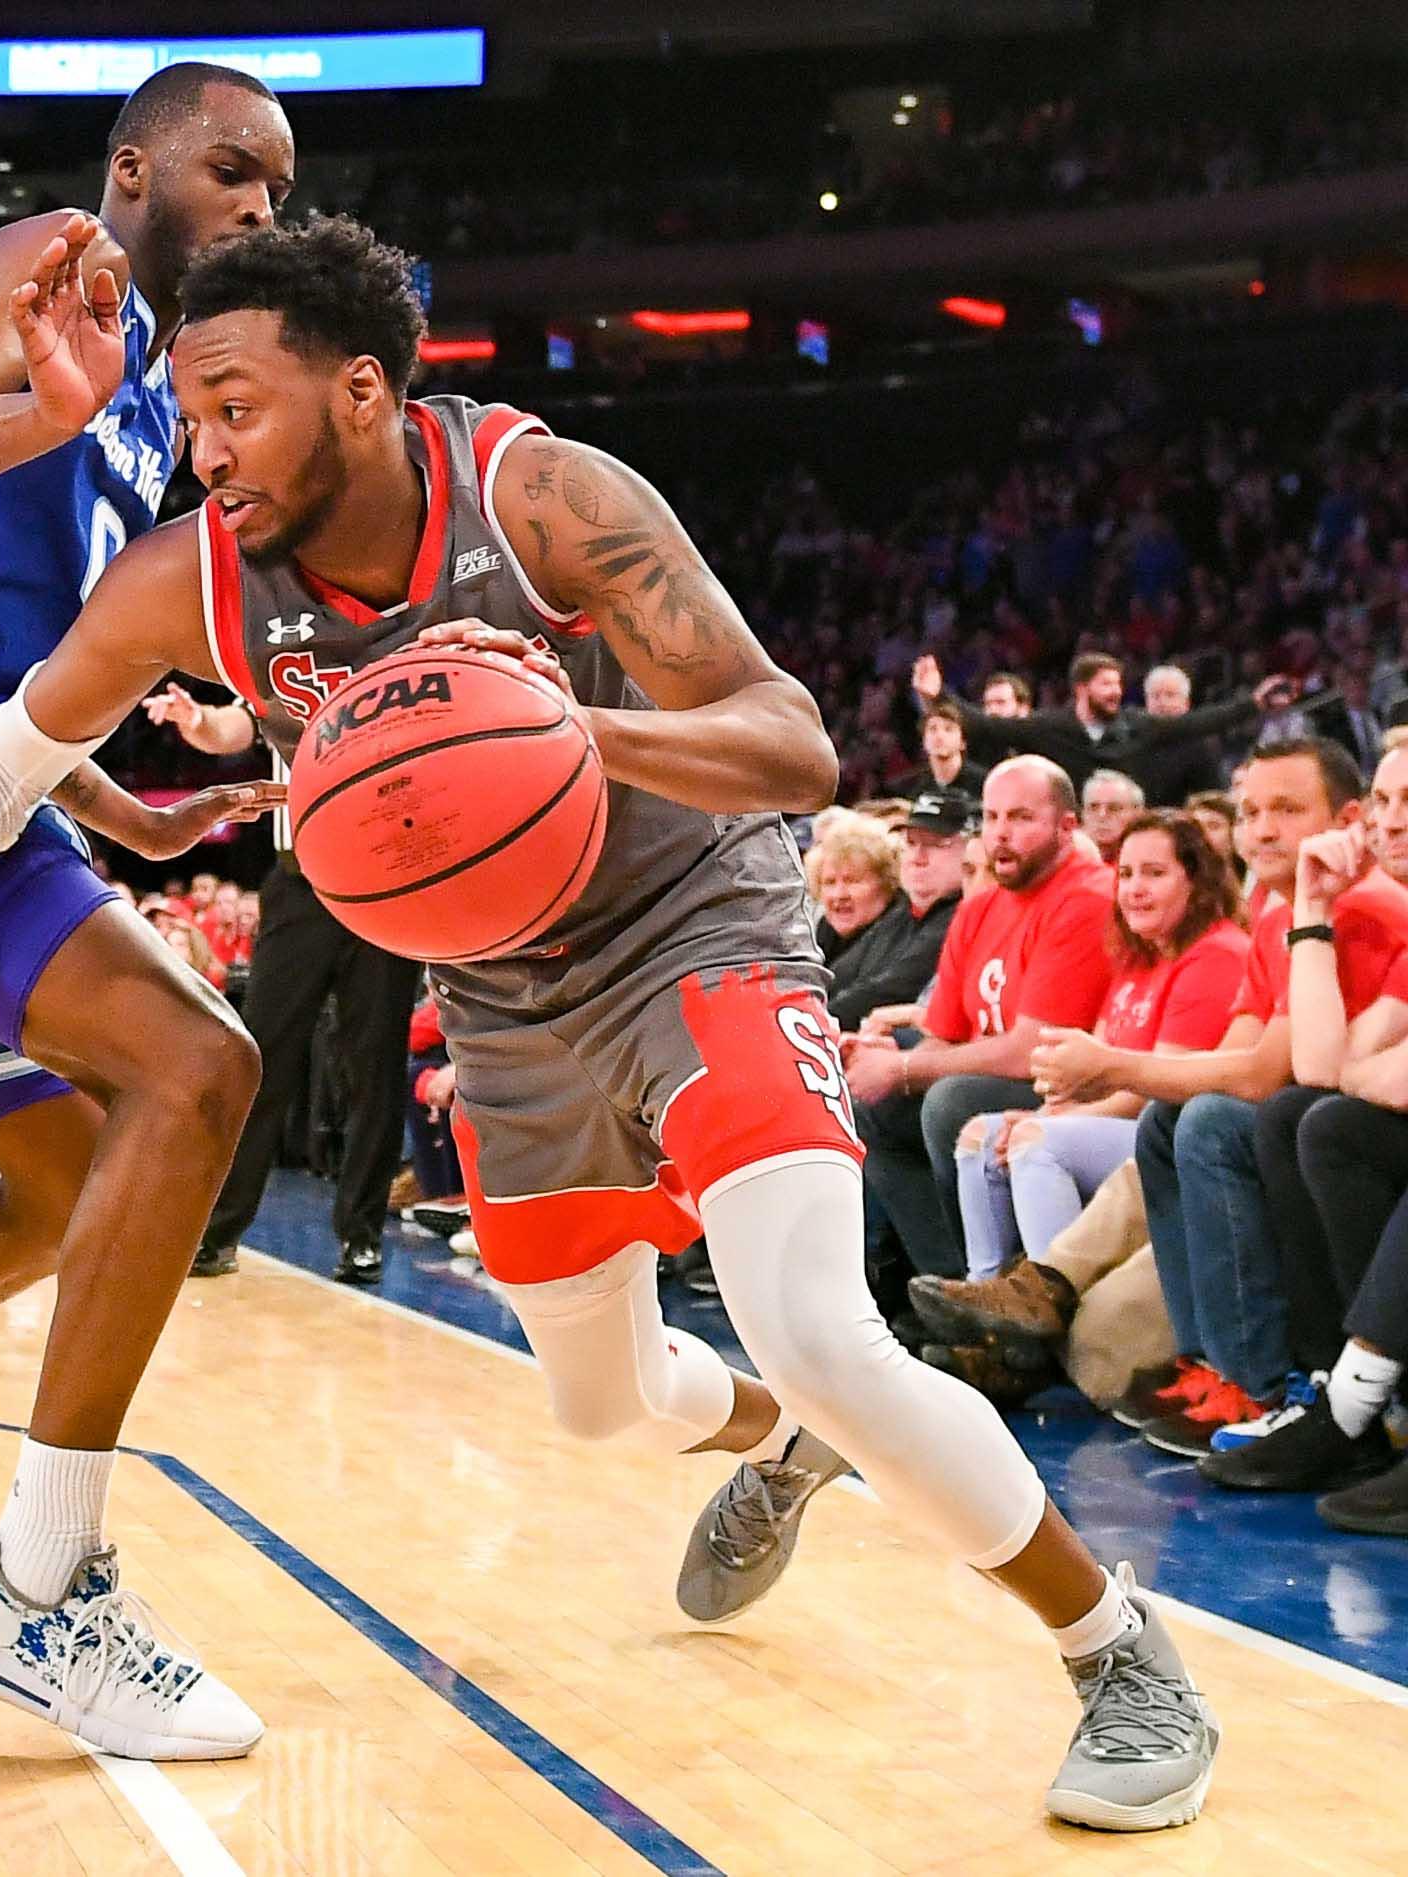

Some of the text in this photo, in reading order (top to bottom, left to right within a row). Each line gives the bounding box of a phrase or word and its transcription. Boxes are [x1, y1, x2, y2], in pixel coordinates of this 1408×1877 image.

[453, 553, 501, 579] EAST
[456, 546, 489, 567] BIG
[314, 672, 453, 760] NCAA
